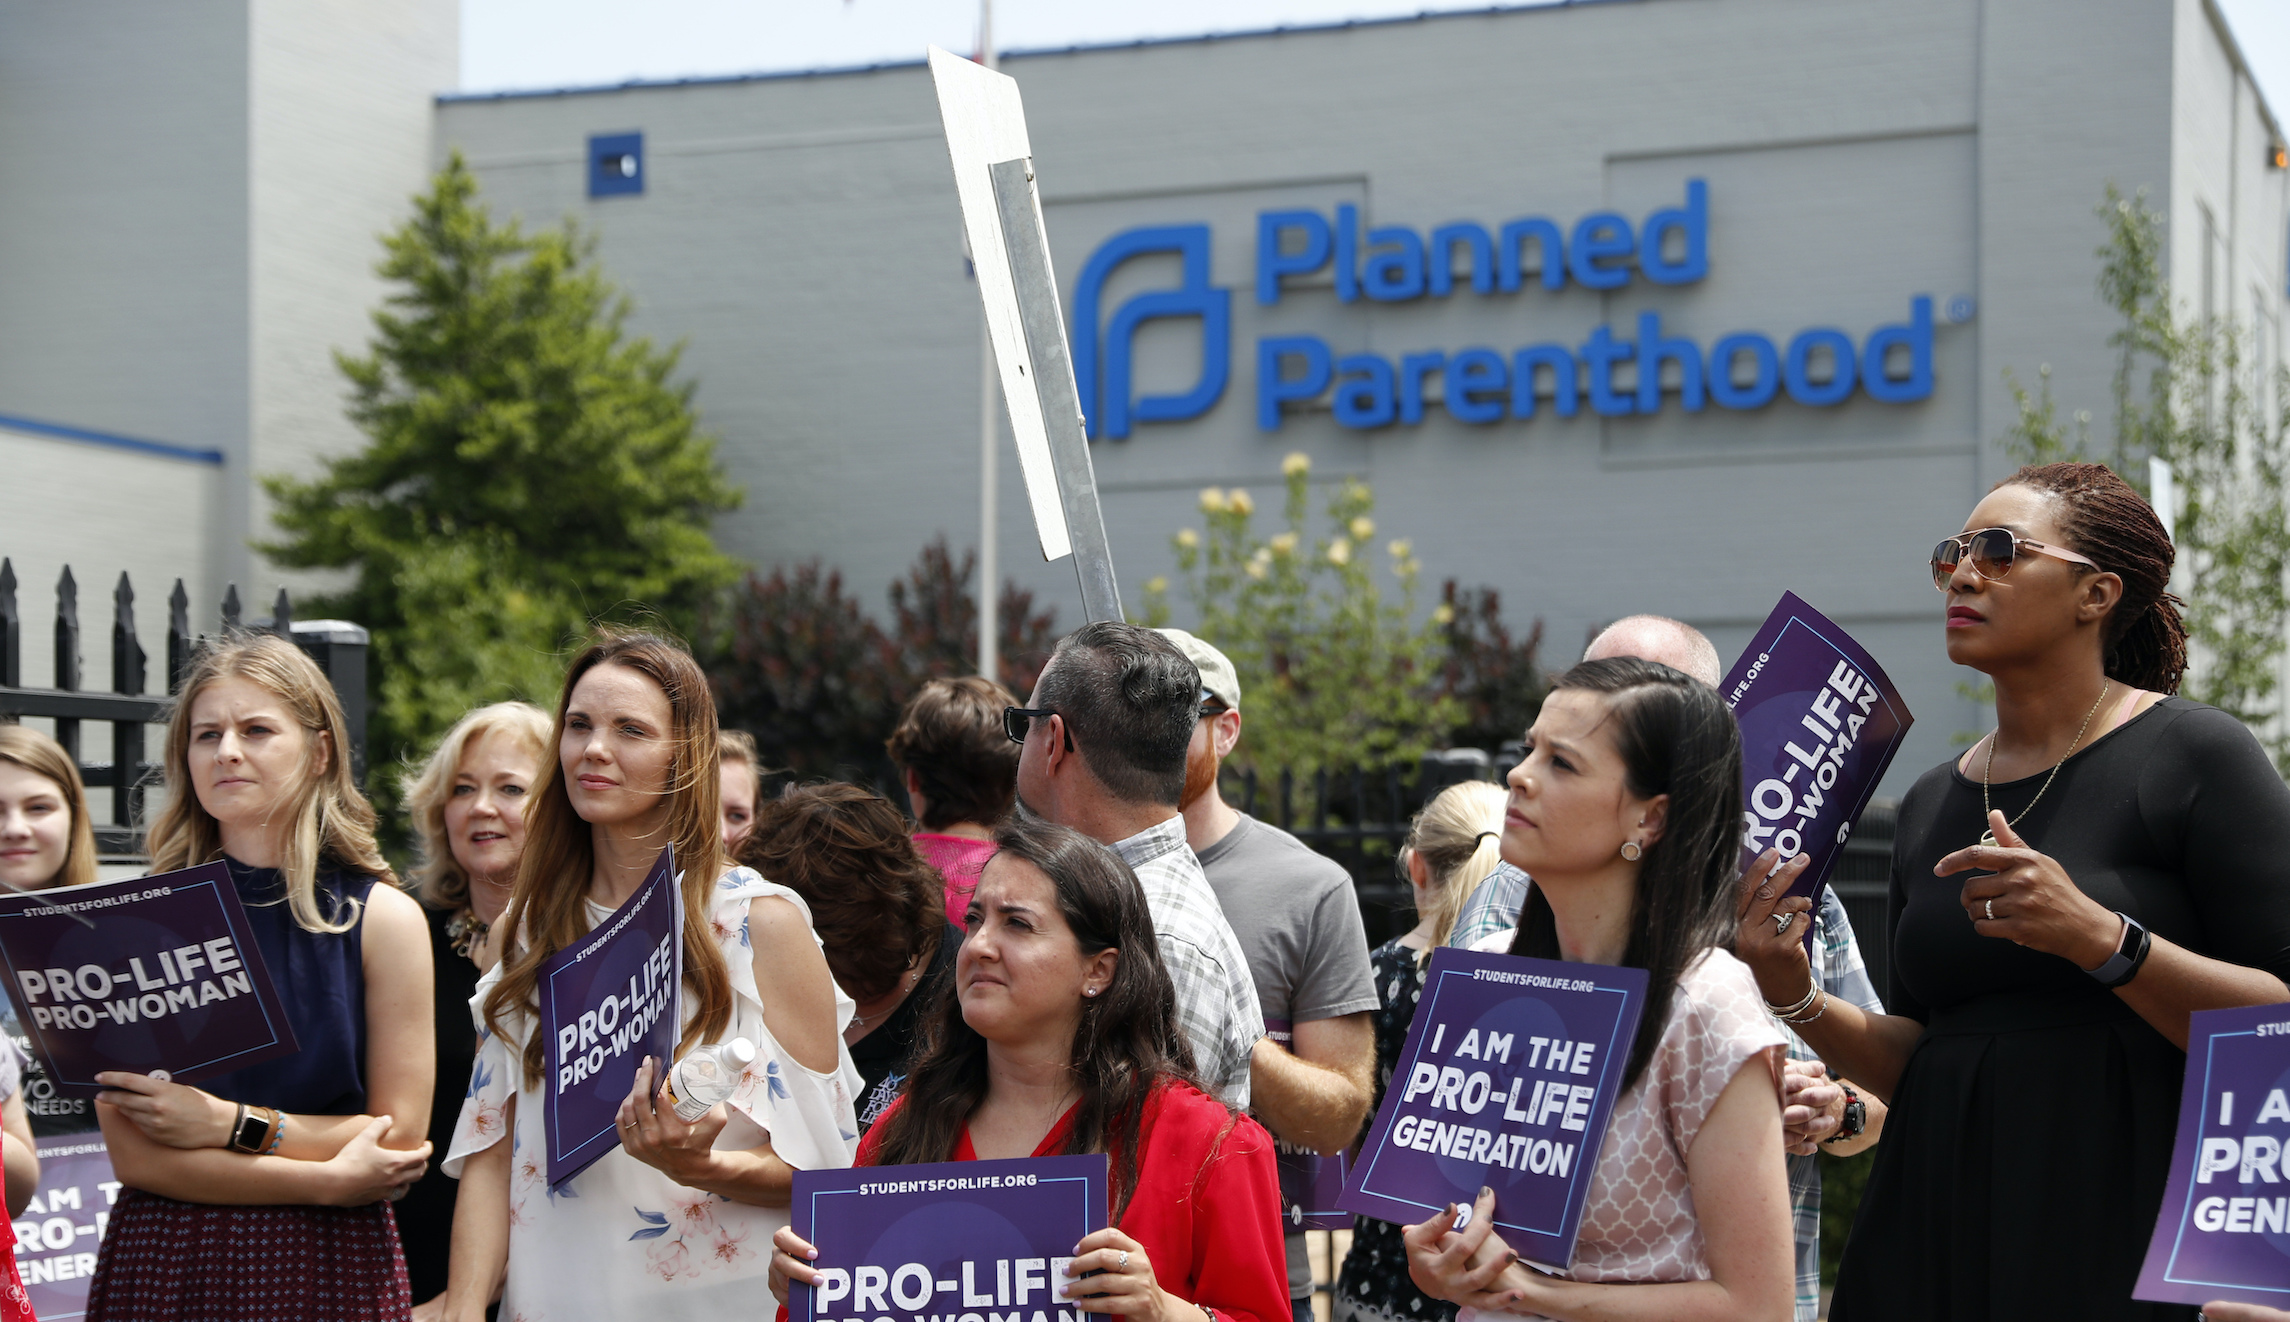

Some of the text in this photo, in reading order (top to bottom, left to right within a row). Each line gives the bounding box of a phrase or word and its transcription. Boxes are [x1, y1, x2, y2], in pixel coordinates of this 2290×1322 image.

[1256, 178, 1709, 305] Planned
[1256, 295, 1935, 431] Parenthood
[1726, 652, 1770, 710] LIFE.ORG
[1742, 658, 1866, 855] RO-LIFE
[1764, 682, 1879, 876] O-WOMAN
[23, 886, 172, 918] STUDENTSFORLIFE.ORG
[575, 886, 653, 963] STUDENTSFORLIFE.ORG
[16, 936, 242, 1004] PRO-LIFE
[1472, 968, 1595, 993] STUDENTSFORLIFE.ORG
[31, 970, 253, 1031] PRO-WOMAN
[558, 932, 671, 1066] PRO-LIFE
[558, 982, 672, 1096] PRO-WOMAN
[1267, 1030, 1292, 1042] STUDENT
[1430, 1023, 1597, 1075] I AM THE
[868, 1087, 900, 1103] DAYS
[878, 1076, 899, 1092] 40
[1403, 1061, 1595, 1133] PRO-LIFE
[2218, 1088, 2290, 1126] I A
[857, 1110, 880, 1125] LIF
[1392, 1115, 1575, 1179] GENERATION
[2196, 1136, 2290, 1184] PR
[859, 1173, 1038, 1196] STUDENTSFORLIFE.ORG
[2193, 1196, 2290, 1234] GEN
[17, 1251, 99, 1286] ENER
